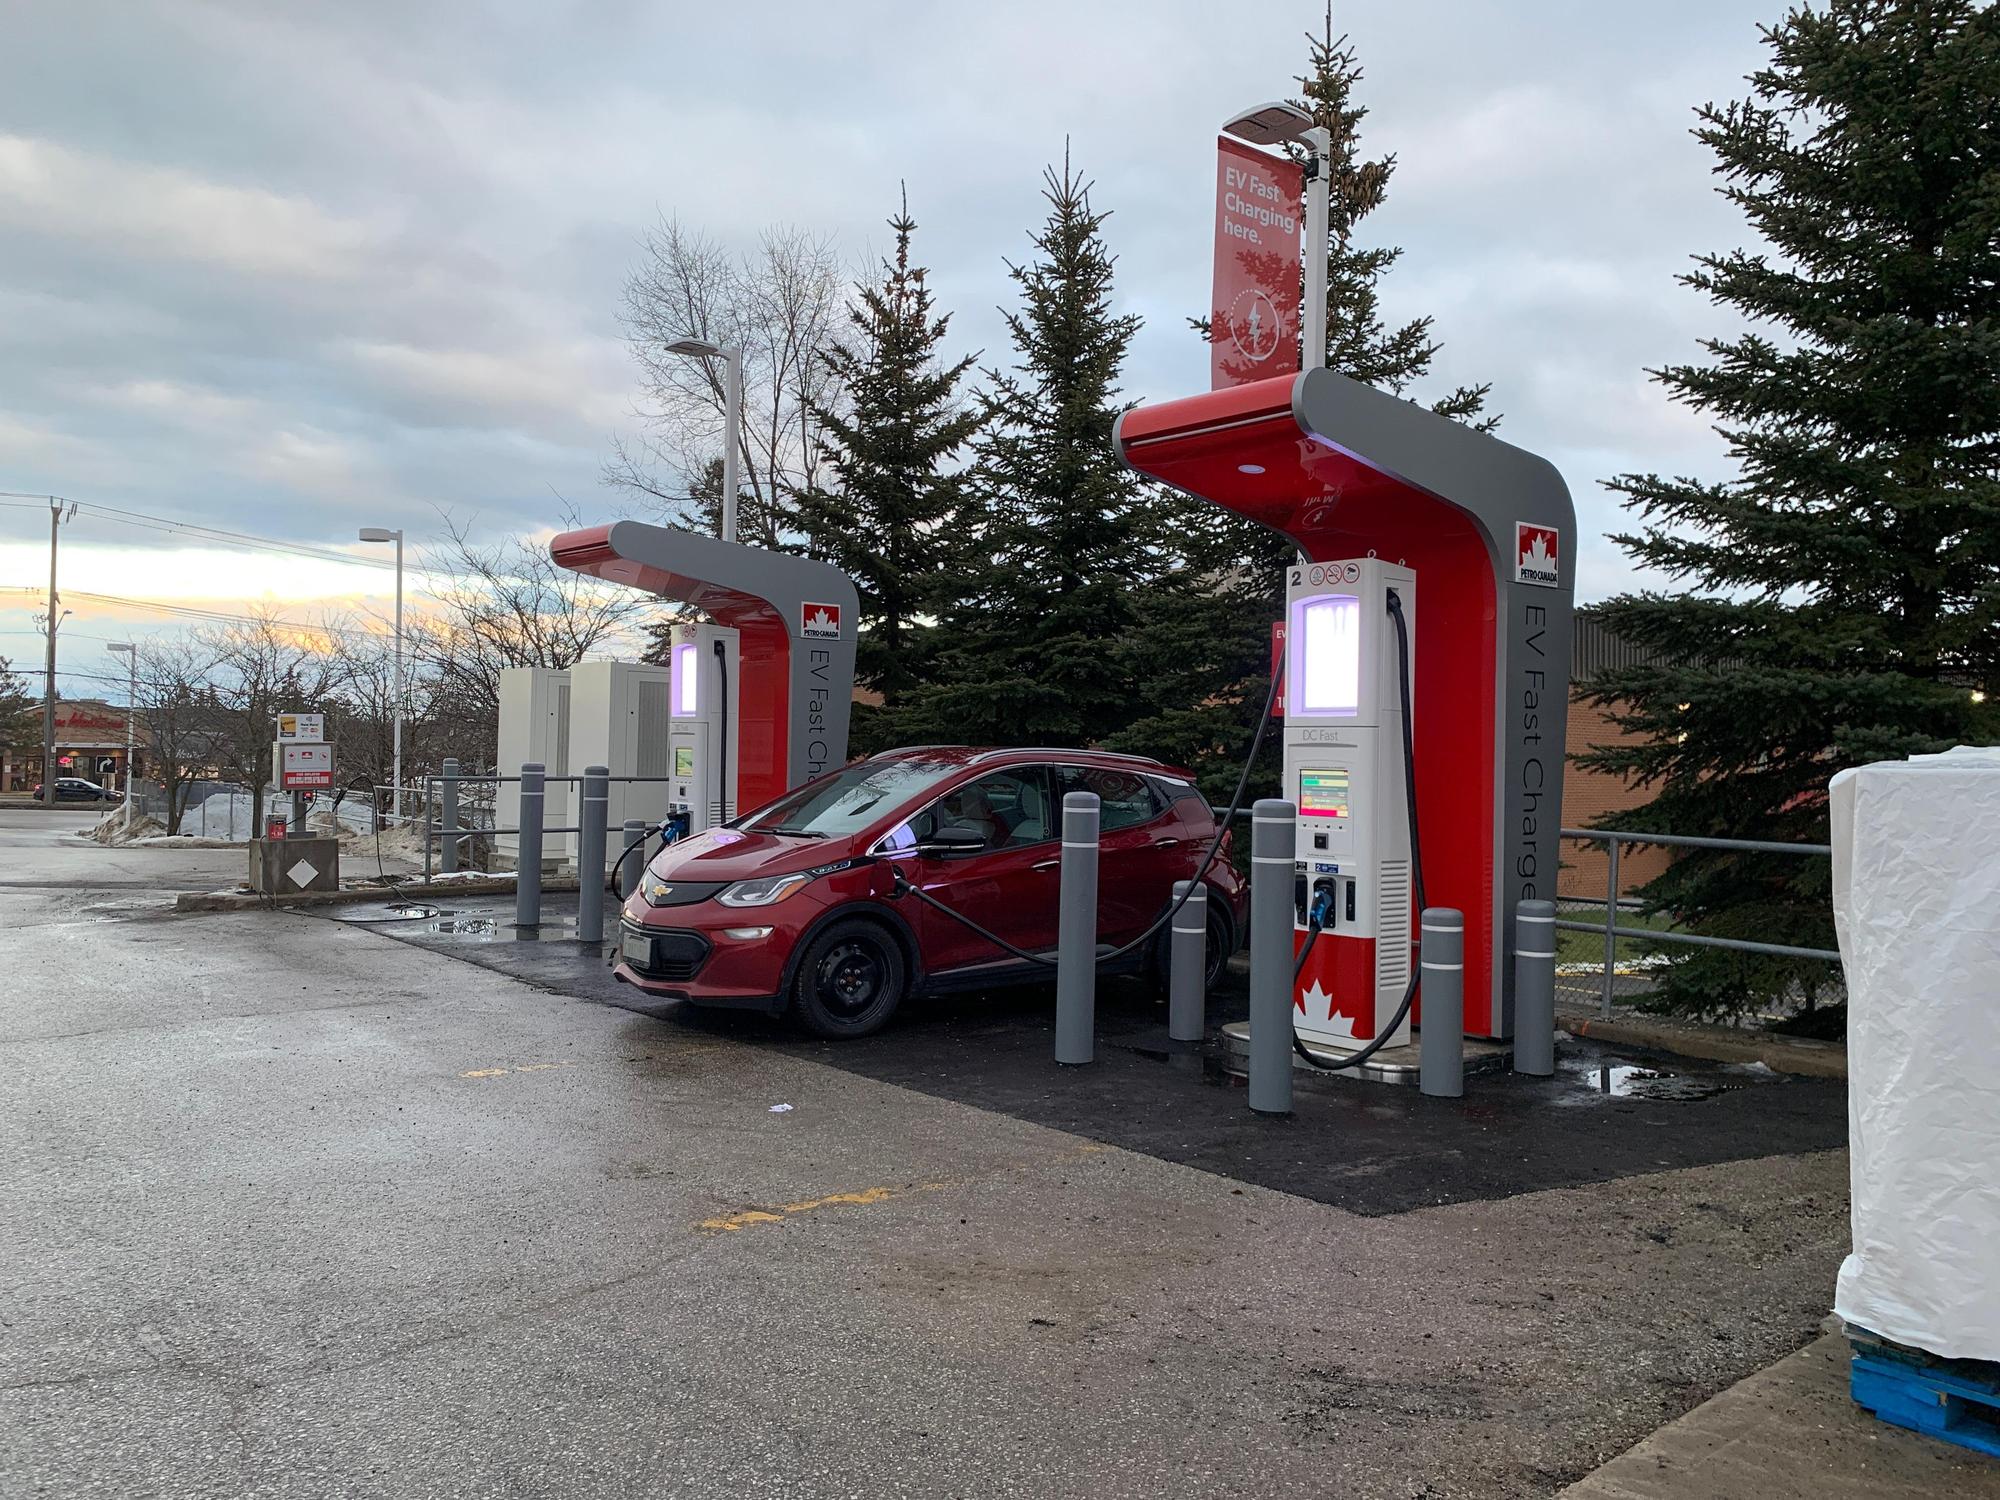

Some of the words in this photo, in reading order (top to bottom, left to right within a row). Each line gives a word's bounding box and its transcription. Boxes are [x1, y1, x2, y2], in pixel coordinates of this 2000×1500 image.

[1226, 166, 1247, 189] EV
[1249, 175, 1280, 203] Fast
[1224, 192, 1295, 234] Charging
[1224, 215, 1262, 245] here.
[1292, 571, 1302, 586] 2
[1526, 605, 1546, 657] EV
[809, 650, 830, 681] EV
[808, 688, 829, 734] Fast
[1523, 670, 1545, 745] Fast
[1302, 729, 1318, 741] DC
[1319, 729, 1339, 741] Fast
[1517, 758, 1544, 900] Charge
